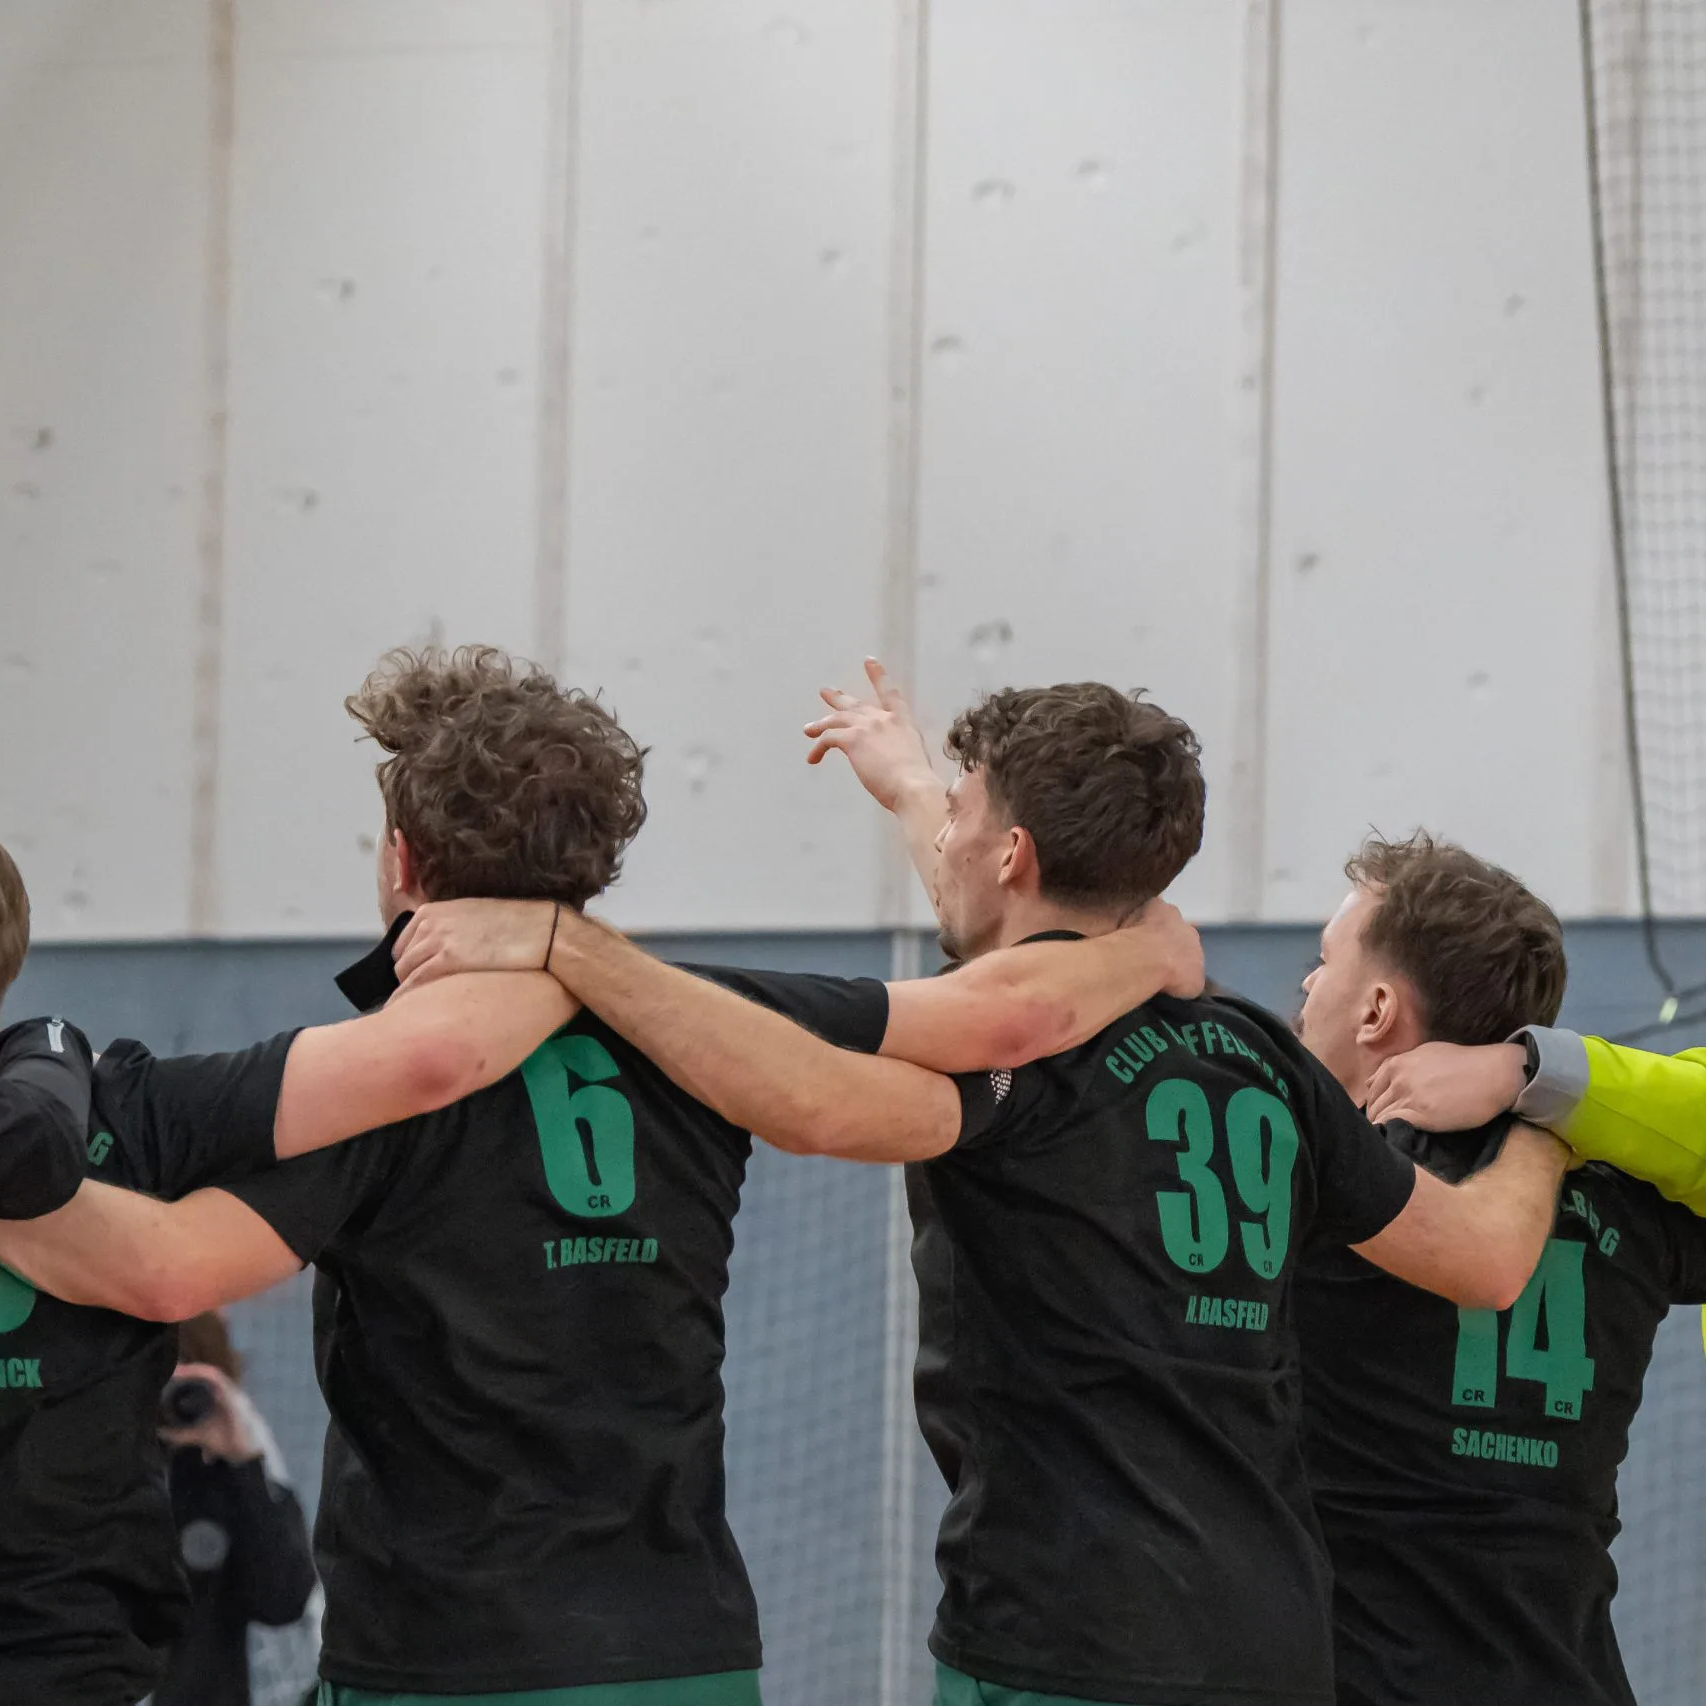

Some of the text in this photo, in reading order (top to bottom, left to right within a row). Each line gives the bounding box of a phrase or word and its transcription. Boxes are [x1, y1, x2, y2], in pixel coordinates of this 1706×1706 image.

[1106, 1026, 1169, 1085] CLUB
[521, 1034, 636, 1218] 6
[1145, 1077, 1299, 1280] 39
[1451, 1427, 1558, 1468] SACHENKO
